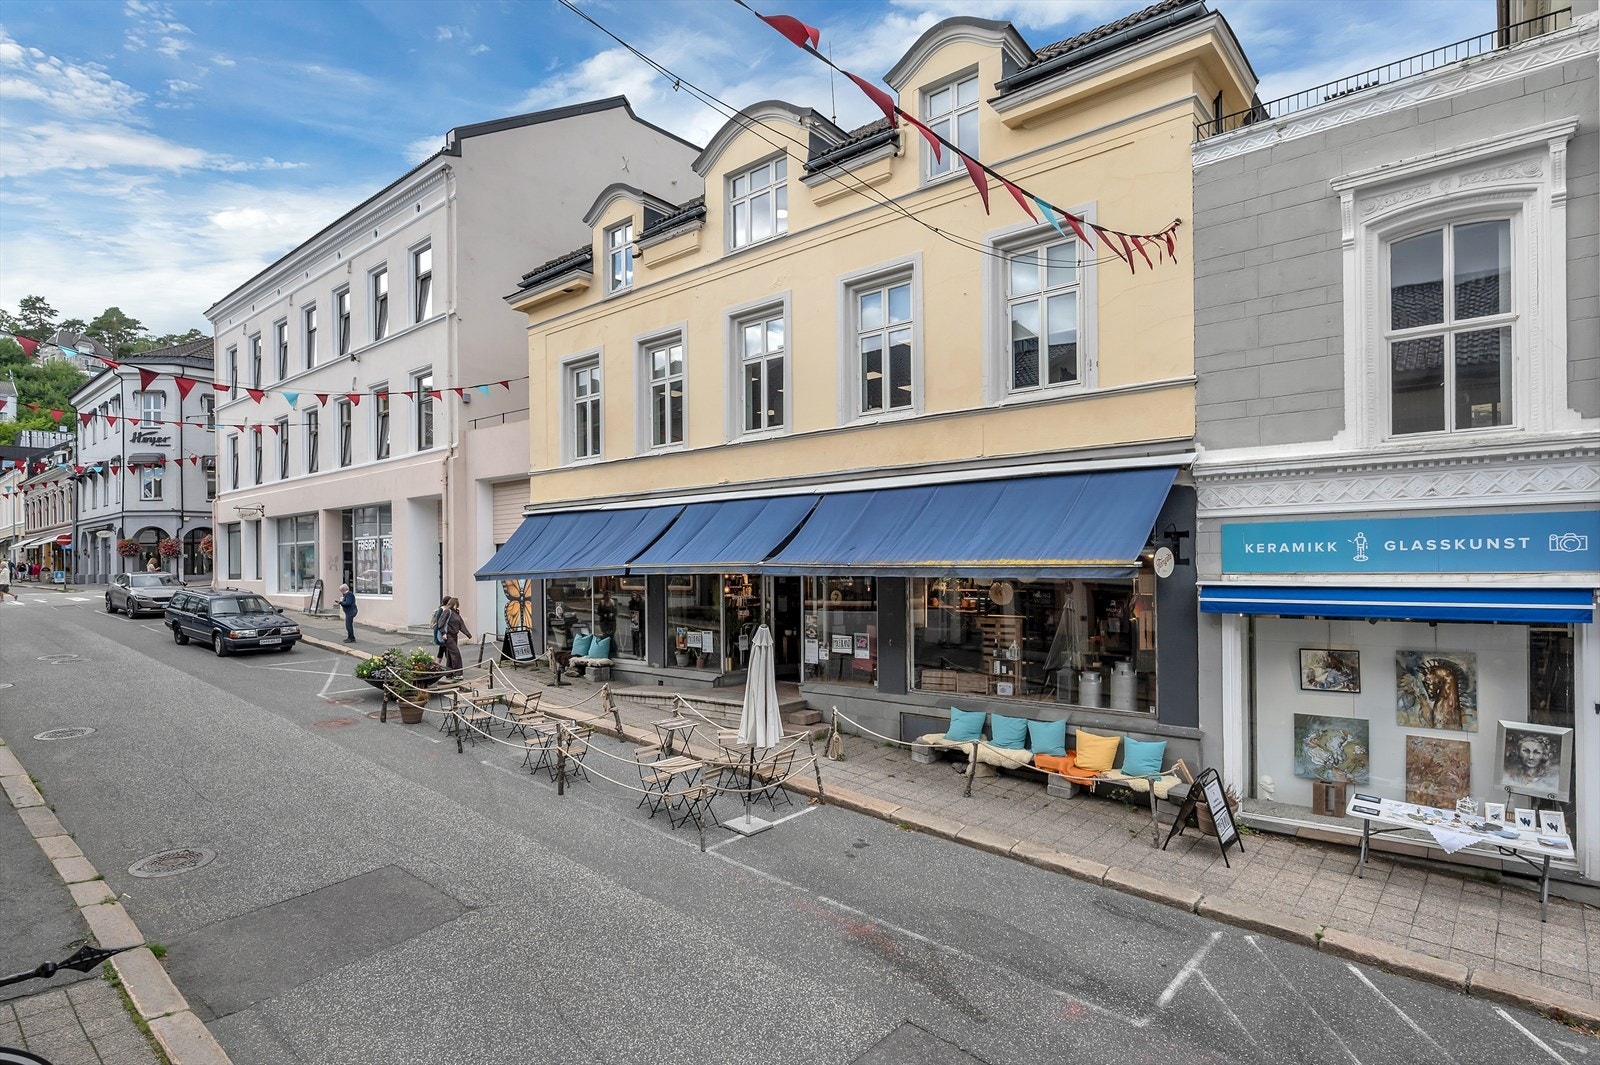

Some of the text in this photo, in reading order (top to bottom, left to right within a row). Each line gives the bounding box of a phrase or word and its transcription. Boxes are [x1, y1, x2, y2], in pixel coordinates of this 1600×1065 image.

[357, 539, 376, 550] FRISØR
[1245, 537, 1530, 553] KERAMIKK GLASSKUNST
